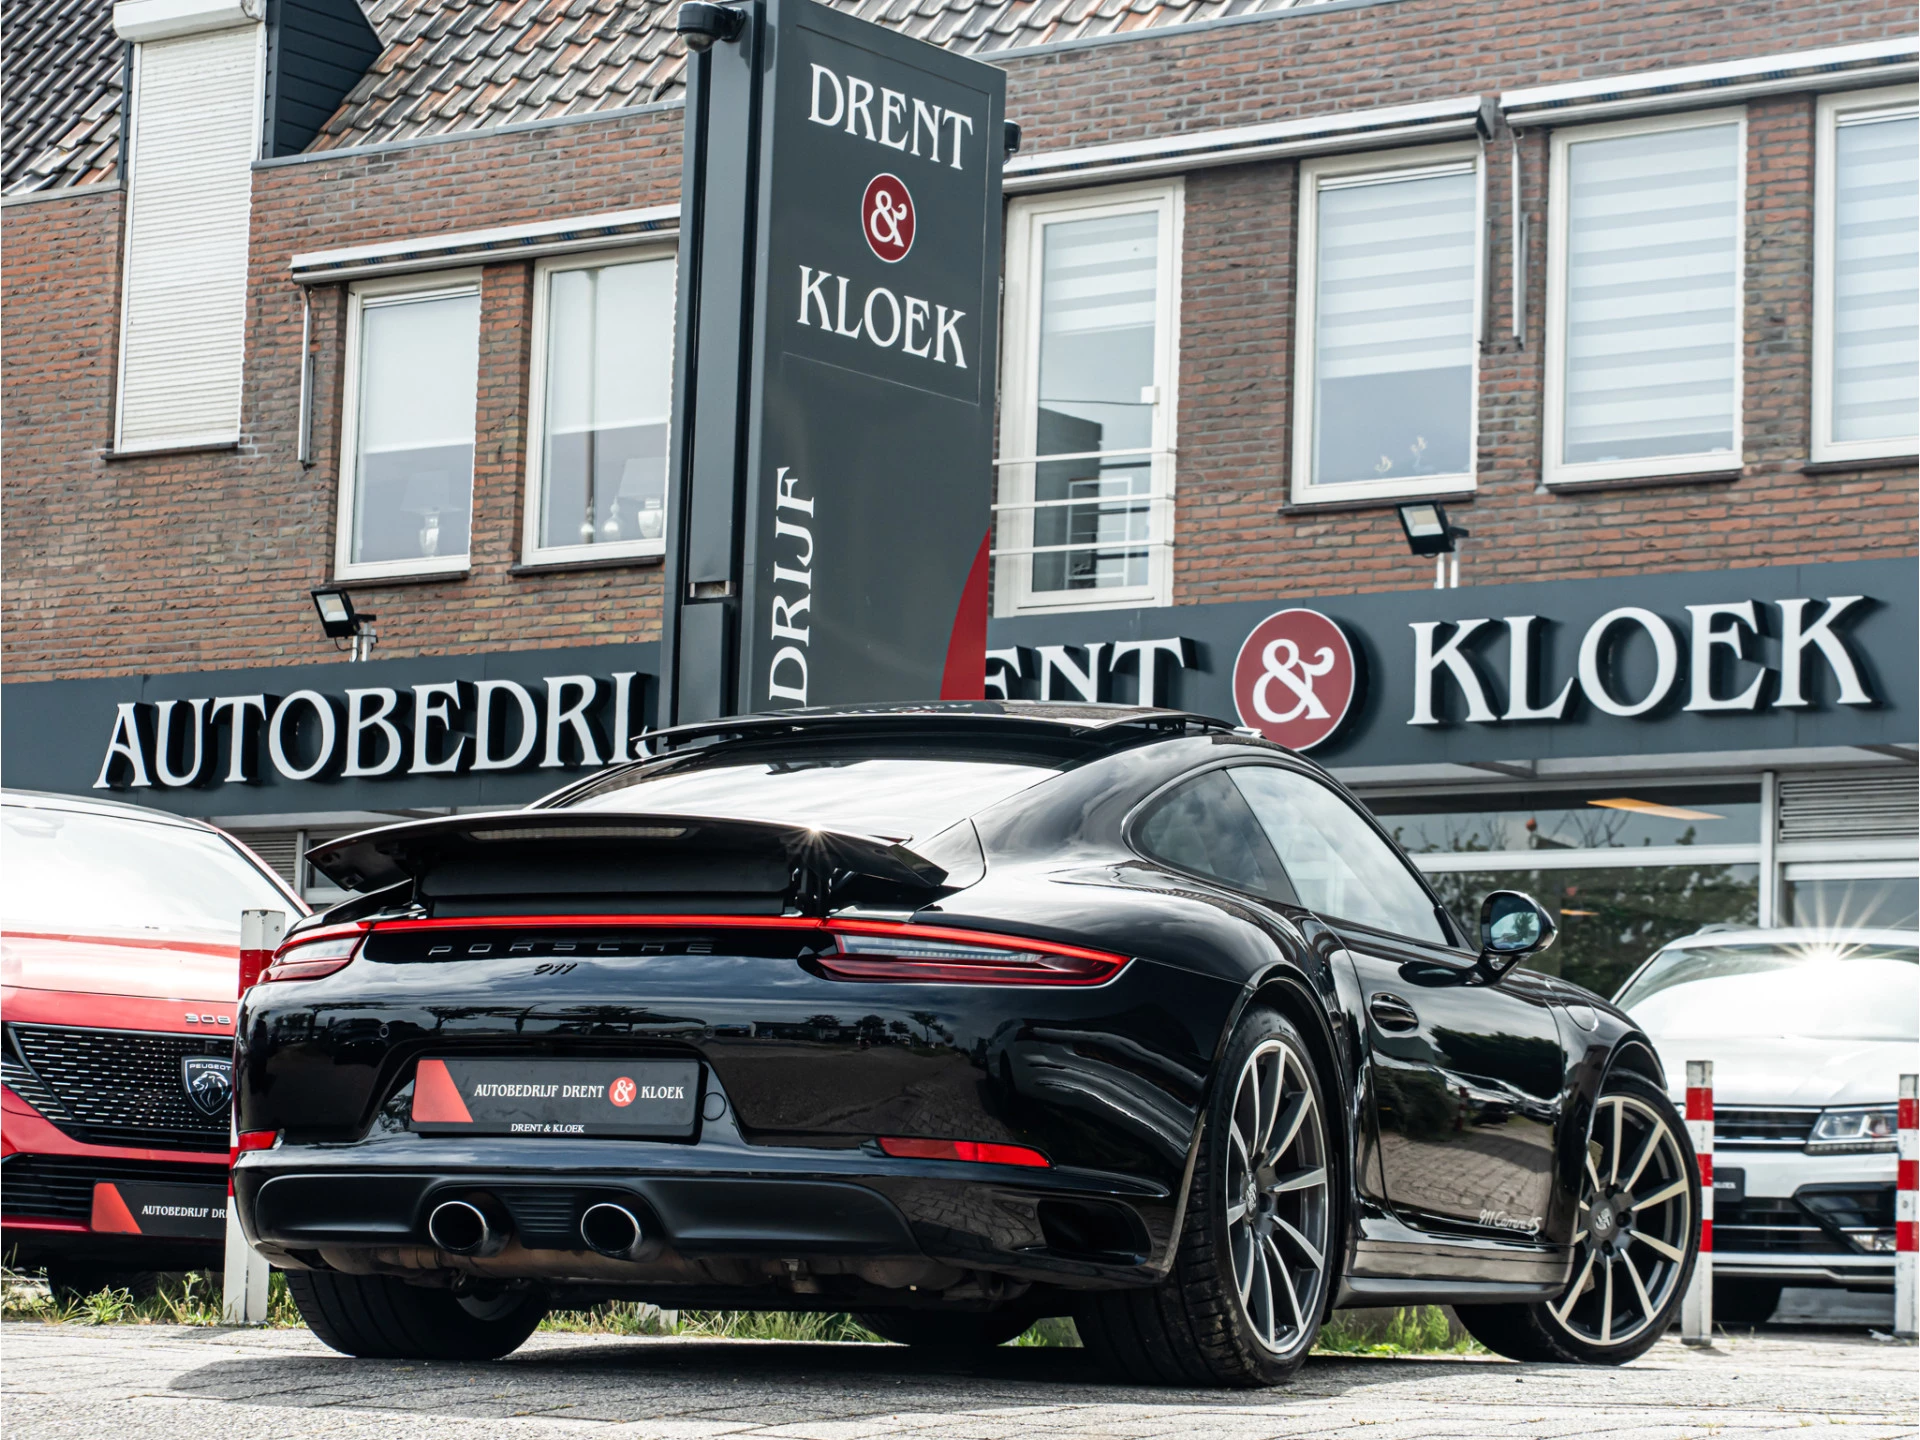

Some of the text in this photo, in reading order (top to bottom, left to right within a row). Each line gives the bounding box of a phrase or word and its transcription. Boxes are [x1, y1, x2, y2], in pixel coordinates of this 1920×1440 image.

[808, 63, 974, 170] DRENT
[871, 190, 908, 247] &
[797, 265, 968, 368] KLOEK
[769, 466, 814, 707] DRIJF
[1252, 638, 1335, 723] &
[1406, 595, 1872, 725] KLOEK
[428, 943, 714, 956] PORSCHE
[533, 962, 578, 976] 911
[184, 1012, 231, 1025] 308
[189, 1063, 232, 1072] PEUGEOT
[474, 1079, 684, 1103] AUTOBEDRIJF DRENT & KLOEK
[510, 1123, 585, 1133] DRENT & KLOEK
[141, 1205, 228, 1219] AUTOBEDRIJF DR
[1478, 1208, 1495, 1226] 911
